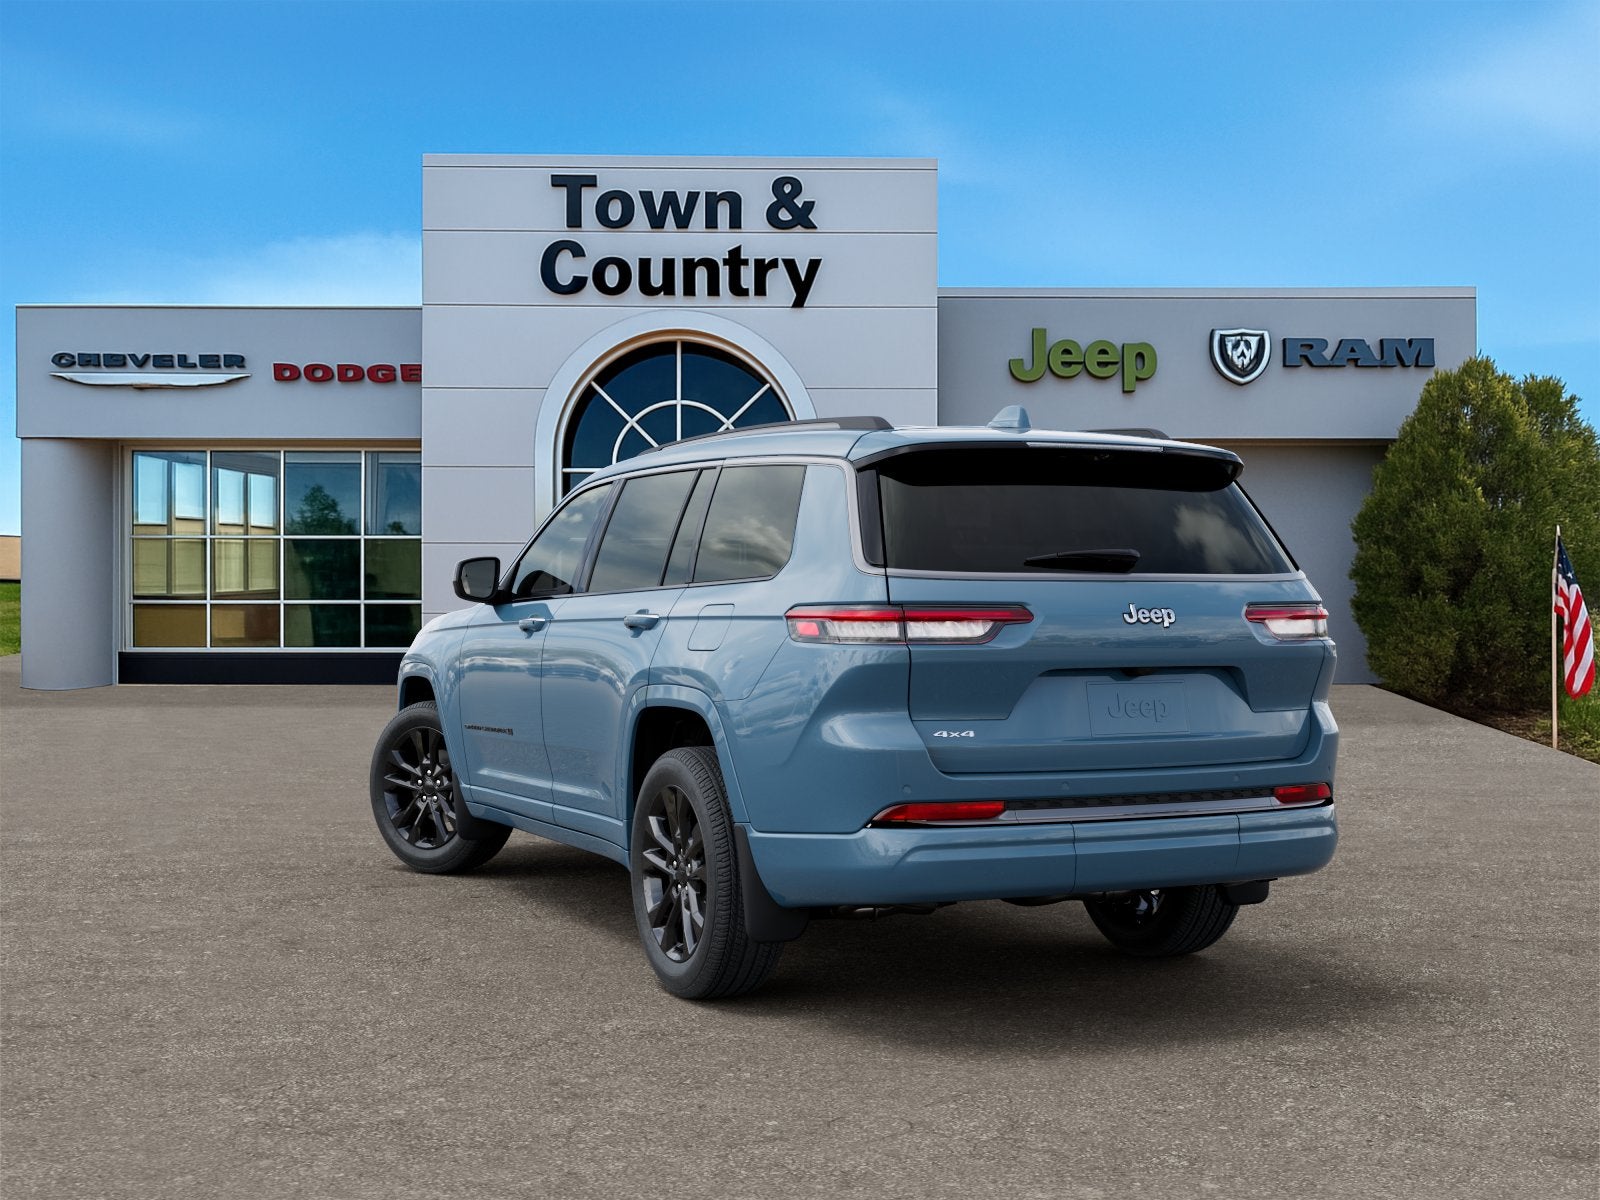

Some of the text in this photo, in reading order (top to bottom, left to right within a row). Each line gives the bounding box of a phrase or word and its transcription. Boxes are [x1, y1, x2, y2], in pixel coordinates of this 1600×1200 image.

[550, 174, 818, 230] Town &
[540, 239, 822, 308] Country
[1009, 328, 1158, 392] Jeep
[1282, 337, 1436, 368] RAM
[273, 362, 422, 383] DODGE
[1123, 602, 1176, 628] Jeep
[1107, 691, 1166, 723] Jeep
